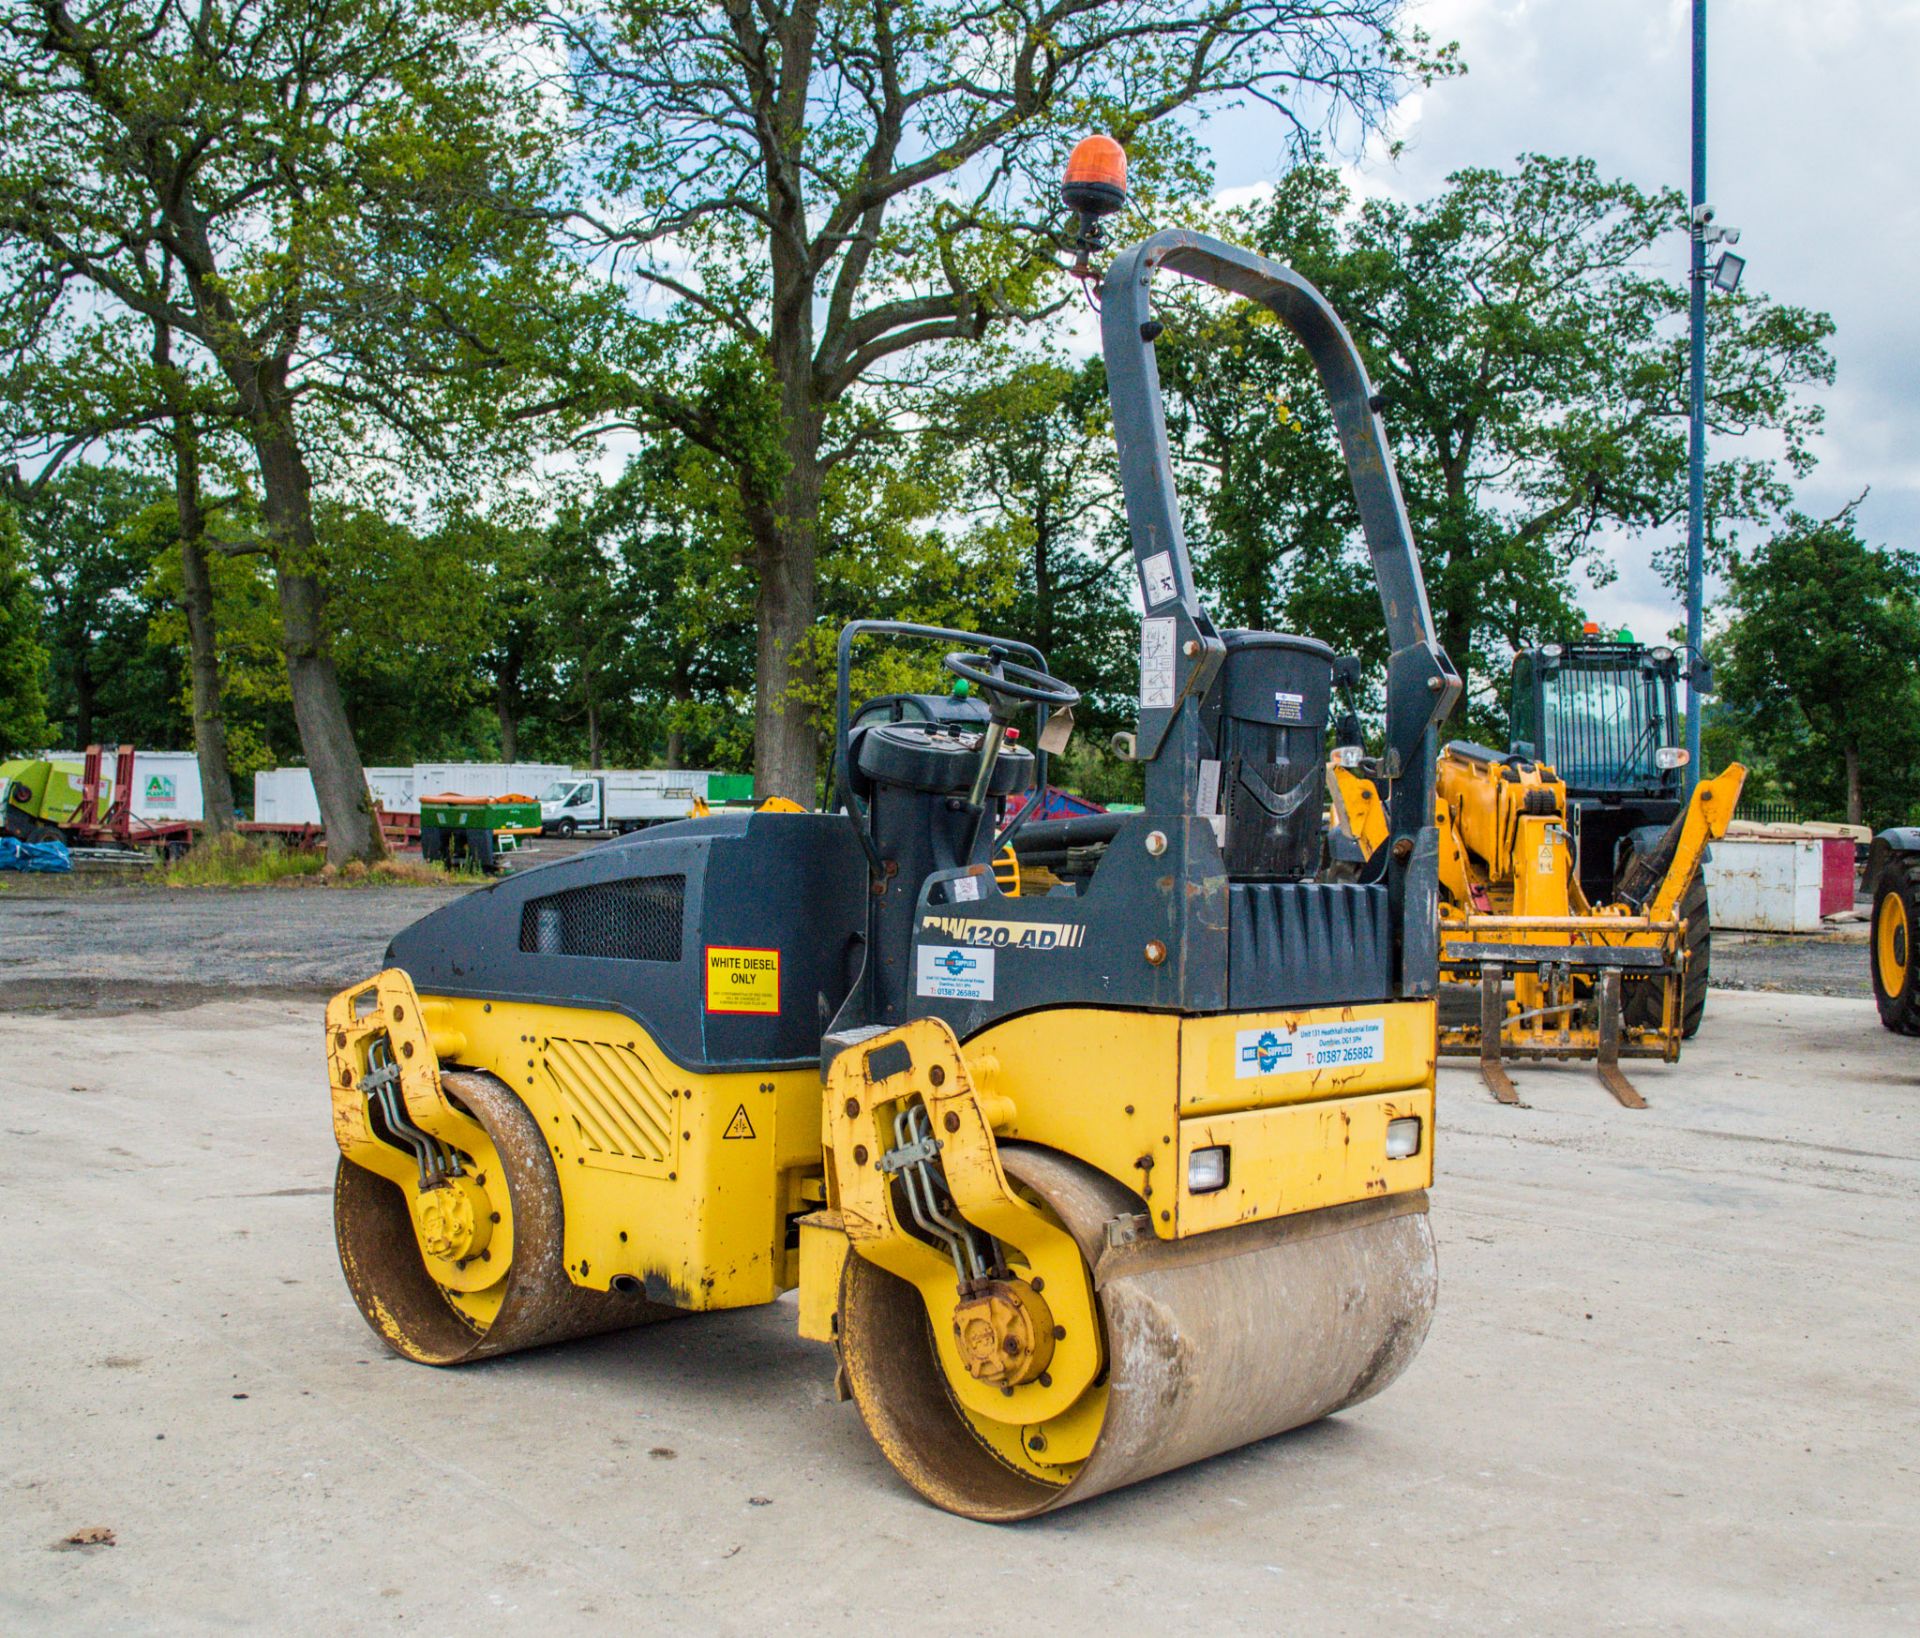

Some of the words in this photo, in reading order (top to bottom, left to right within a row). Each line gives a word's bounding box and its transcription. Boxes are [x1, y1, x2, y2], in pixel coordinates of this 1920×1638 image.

[967, 925, 1010, 947] 120
[1016, 929, 1058, 950] AD
[710, 956, 741, 969] WHITE
[743, 958, 777, 971] DIESEL
[731, 972, 757, 985] ONLY
[937, 988, 955, 996] 01387
[956, 989, 981, 998] 265882
[1300, 1030, 1312, 1039] Unit
[1365, 1023, 1379, 1032] Estate
[1306, 1053, 1315, 1065] T:
[1316, 1049, 1342, 1065] 01387
[1343, 1046, 1374, 1061] 265882
